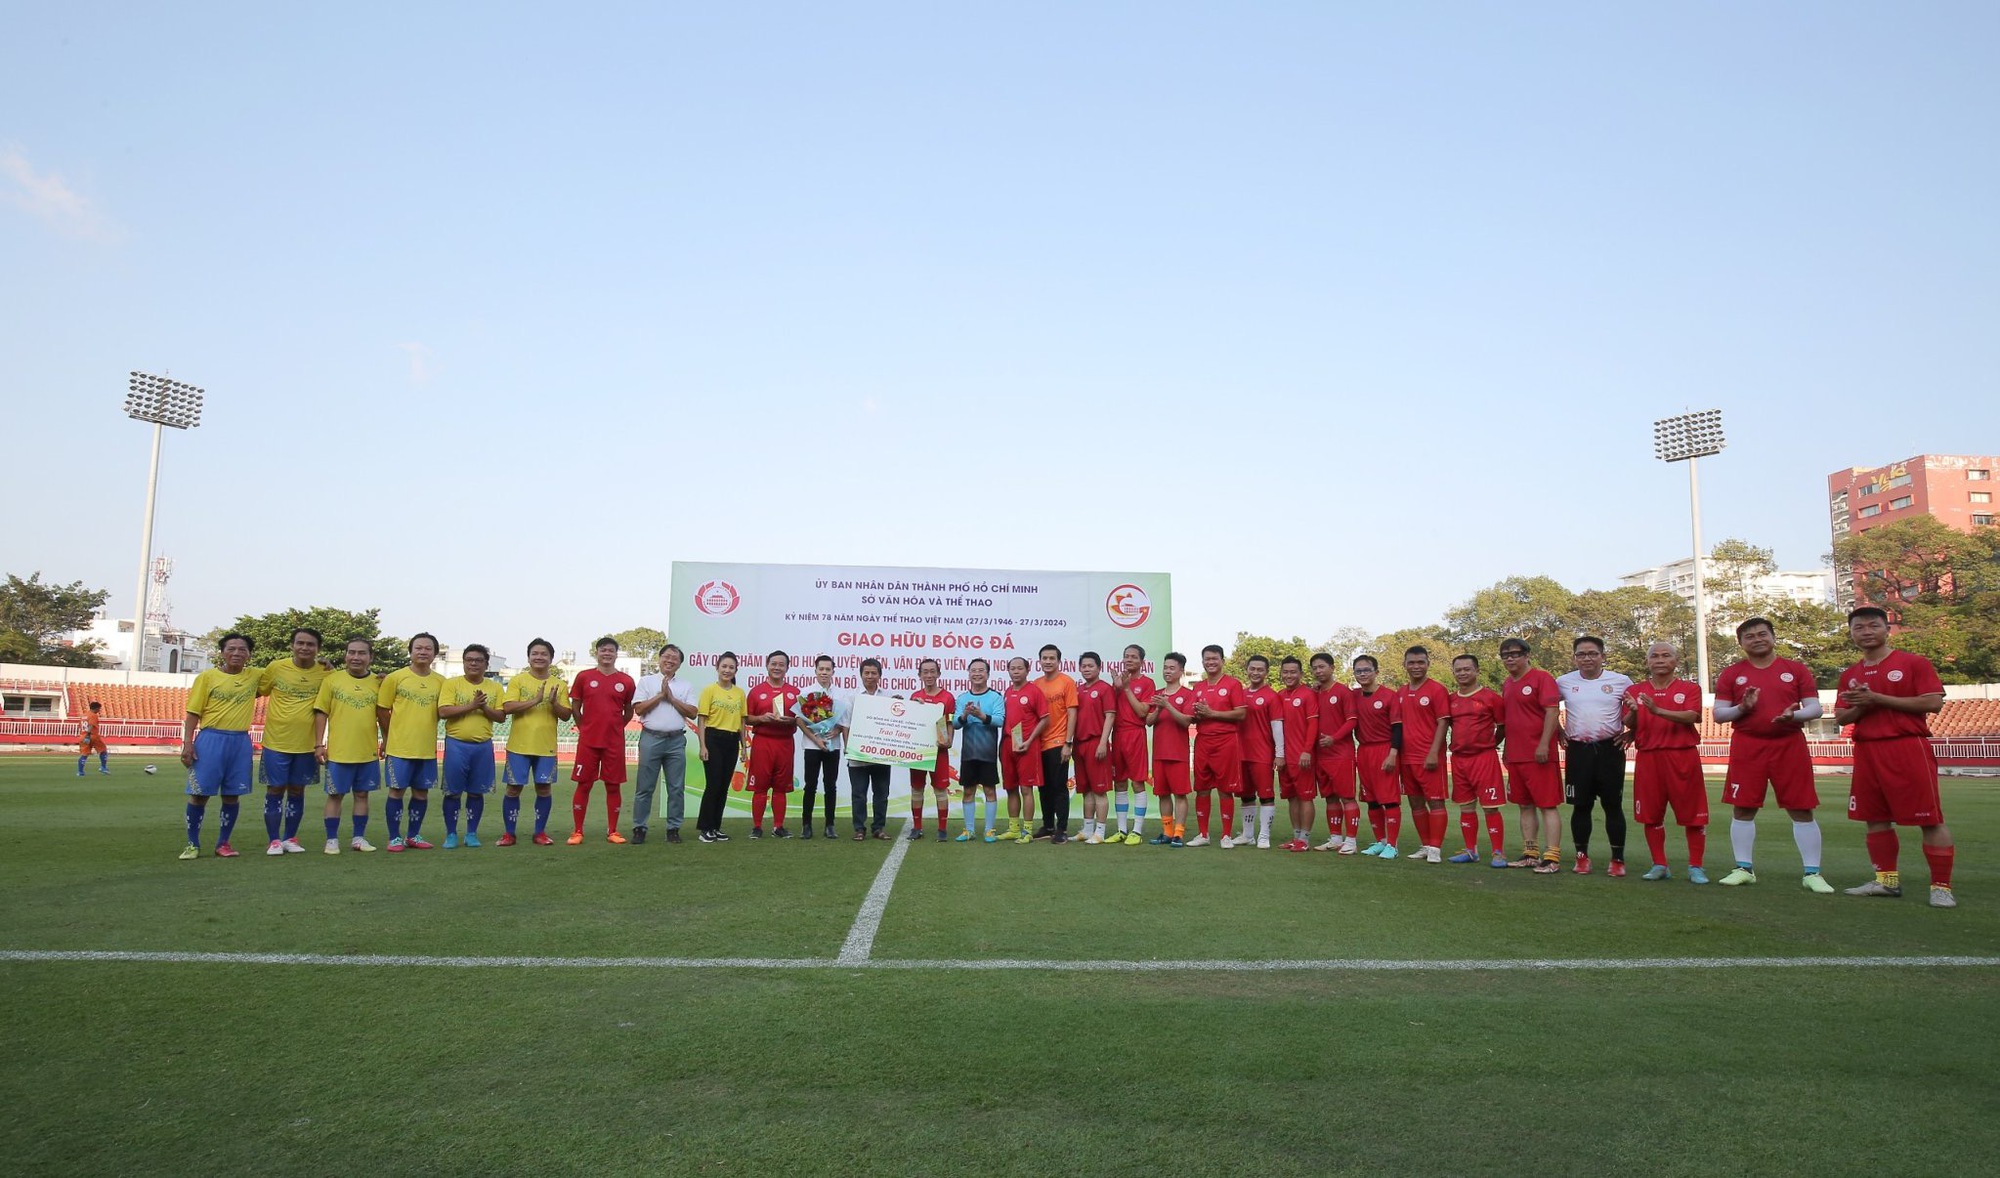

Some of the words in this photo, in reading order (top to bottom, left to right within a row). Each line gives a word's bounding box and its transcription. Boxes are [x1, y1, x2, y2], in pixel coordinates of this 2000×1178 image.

[831, 581, 852, 590] BAN
[856, 580, 884, 590] NHÂN
[888, 580, 909, 590] DÂN
[912, 581, 946, 592] THÀNH
[949, 581, 970, 592] PHỐ
[991, 582, 1010, 593] CHÍ
[1012, 585, 1038, 594] MINH
[862, 594, 876, 604] SỞ
[878, 595, 900, 604] VĂN
[903, 595, 926, 606] HÓA
[928, 596, 942, 606] VÀ
[946, 594, 963, 606] THỂ
[966, 598, 993, 607] THAO
[798, 612, 820, 622] NIỆM
[834, 613, 854, 622] NĂM
[856, 613, 880, 622] NGÀY
[900, 616, 922, 624] THAO
[924, 615, 941, 625] VIỆT
[966, 618, 1013, 626] (27/3/1946
[1020, 618, 1066, 627] 27/3/2024)
[838, 632, 884, 646] GIAO
[890, 631, 926, 648] HỮU
[932, 632, 984, 649] BÓNG
[990, 633, 1015, 650] ĐÁ
[689, 652, 709, 667] GÂY
[894, 655, 912, 672] VẬN
[891, 676, 916, 690] CHỨC
[576, 764, 582, 776] 7
[1731, 783, 1740, 798] 7
